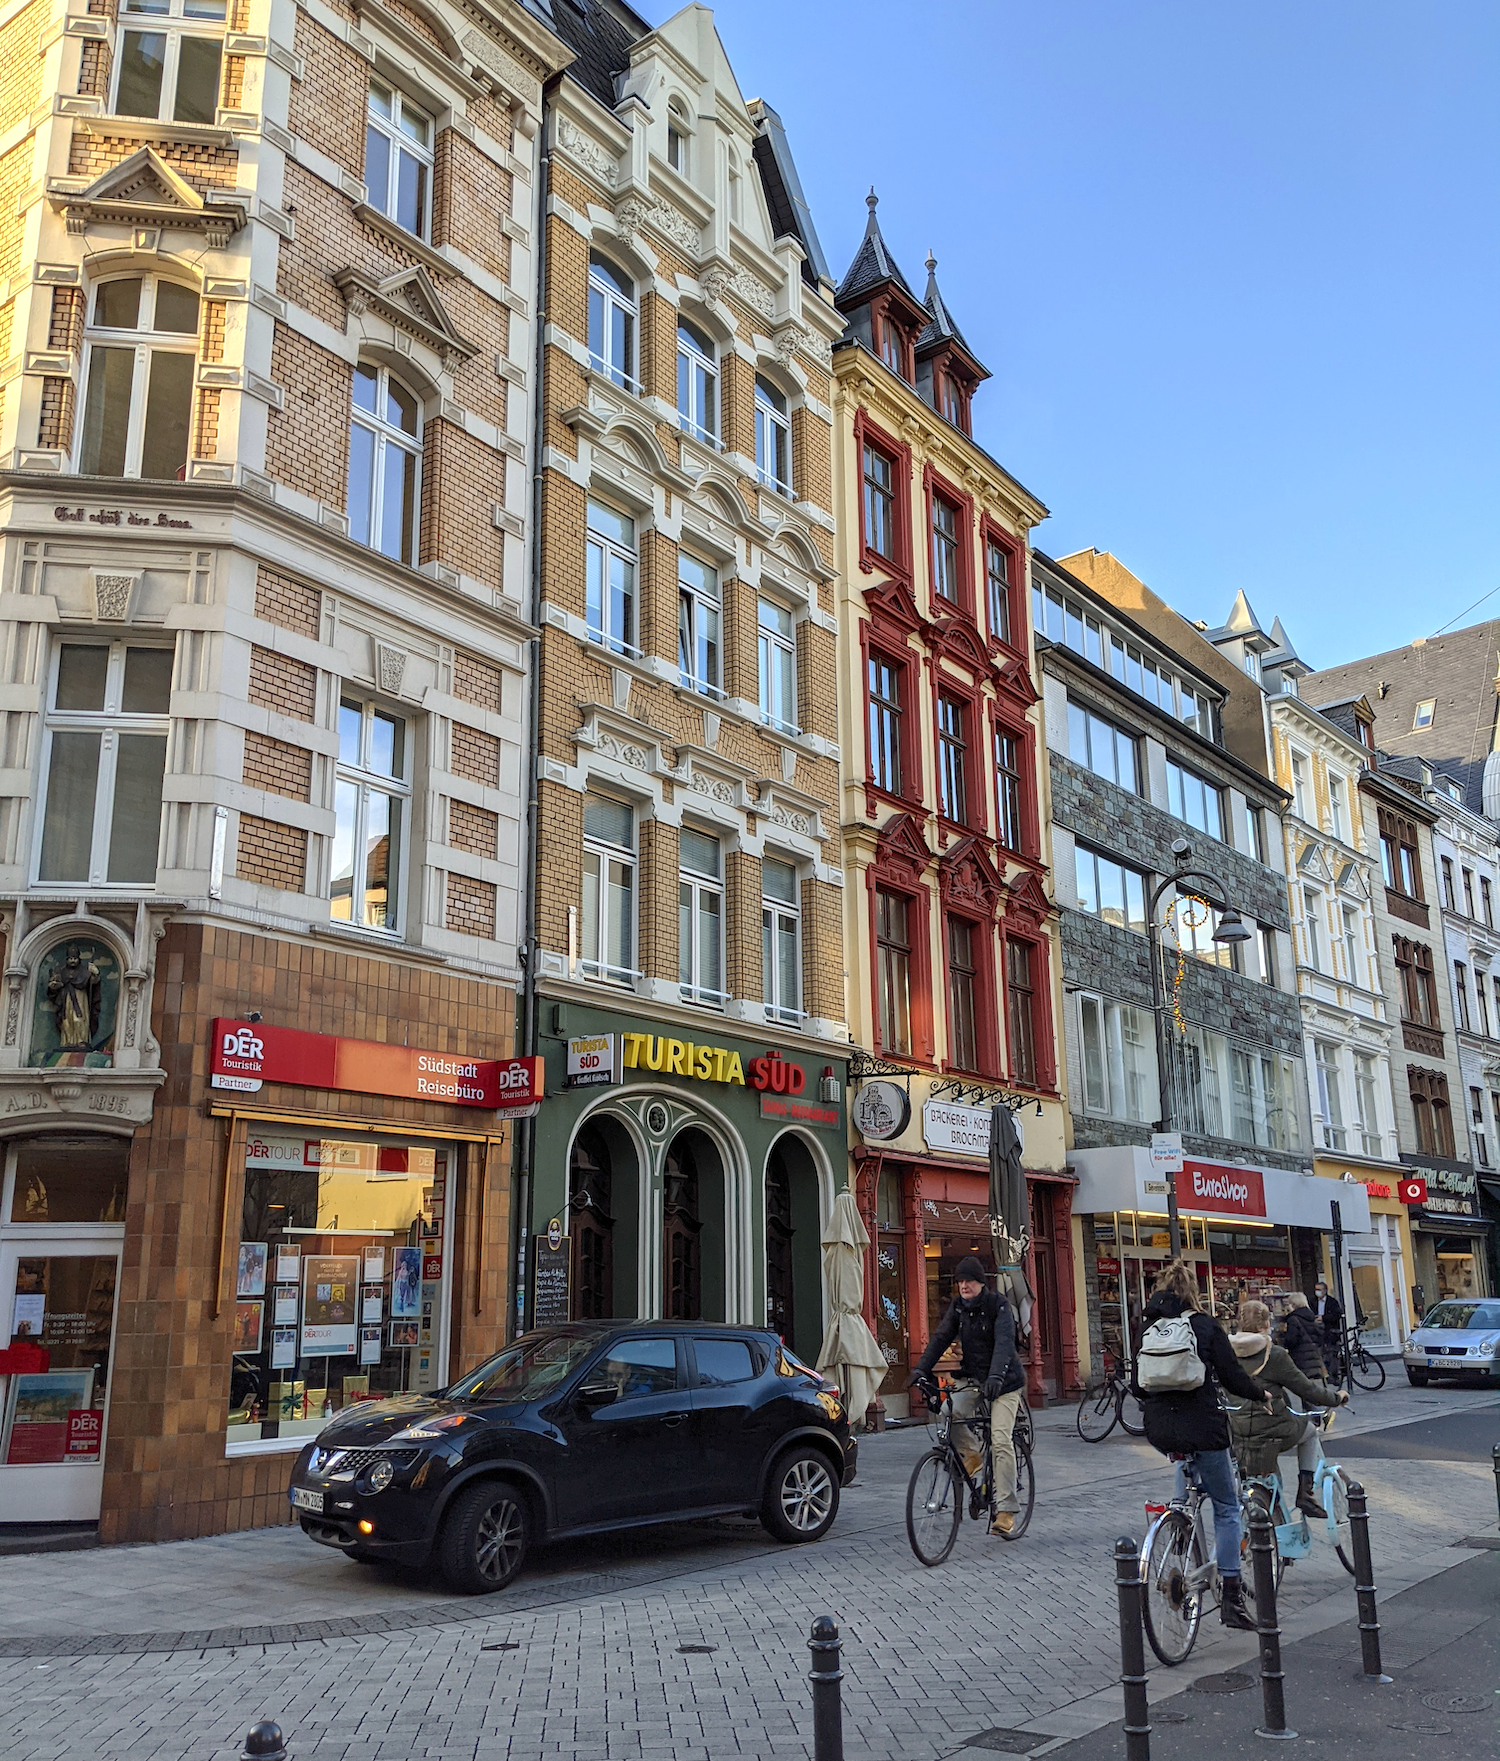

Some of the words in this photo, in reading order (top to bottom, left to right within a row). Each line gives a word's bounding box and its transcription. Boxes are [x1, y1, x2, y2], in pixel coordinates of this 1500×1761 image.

[54, 506, 84, 521] Gott
[223, 1031, 264, 1060] DER
[571, 1038, 609, 1054] TURISTA
[222, 1057, 262, 1071] Touristik
[418, 1056, 478, 1079] Südstadt
[580, 1053, 600, 1069] SÜD
[626, 1032, 745, 1085] TURISTA
[750, 1051, 806, 1095] SÜD
[218, 1077, 253, 1089] Partner
[499, 1065, 530, 1089] DER
[417, 1078, 484, 1100] Reisebüro
[500, 1089, 530, 1099] Touristik
[503, 1108, 528, 1117] Partner
[931, 1109, 968, 1127] BÄCKEREI
[1192, 1171, 1248, 1207] EuroShop
[45, 1312, 87, 1321] ffnungszeiten
[71, 1416, 98, 1431] DER
